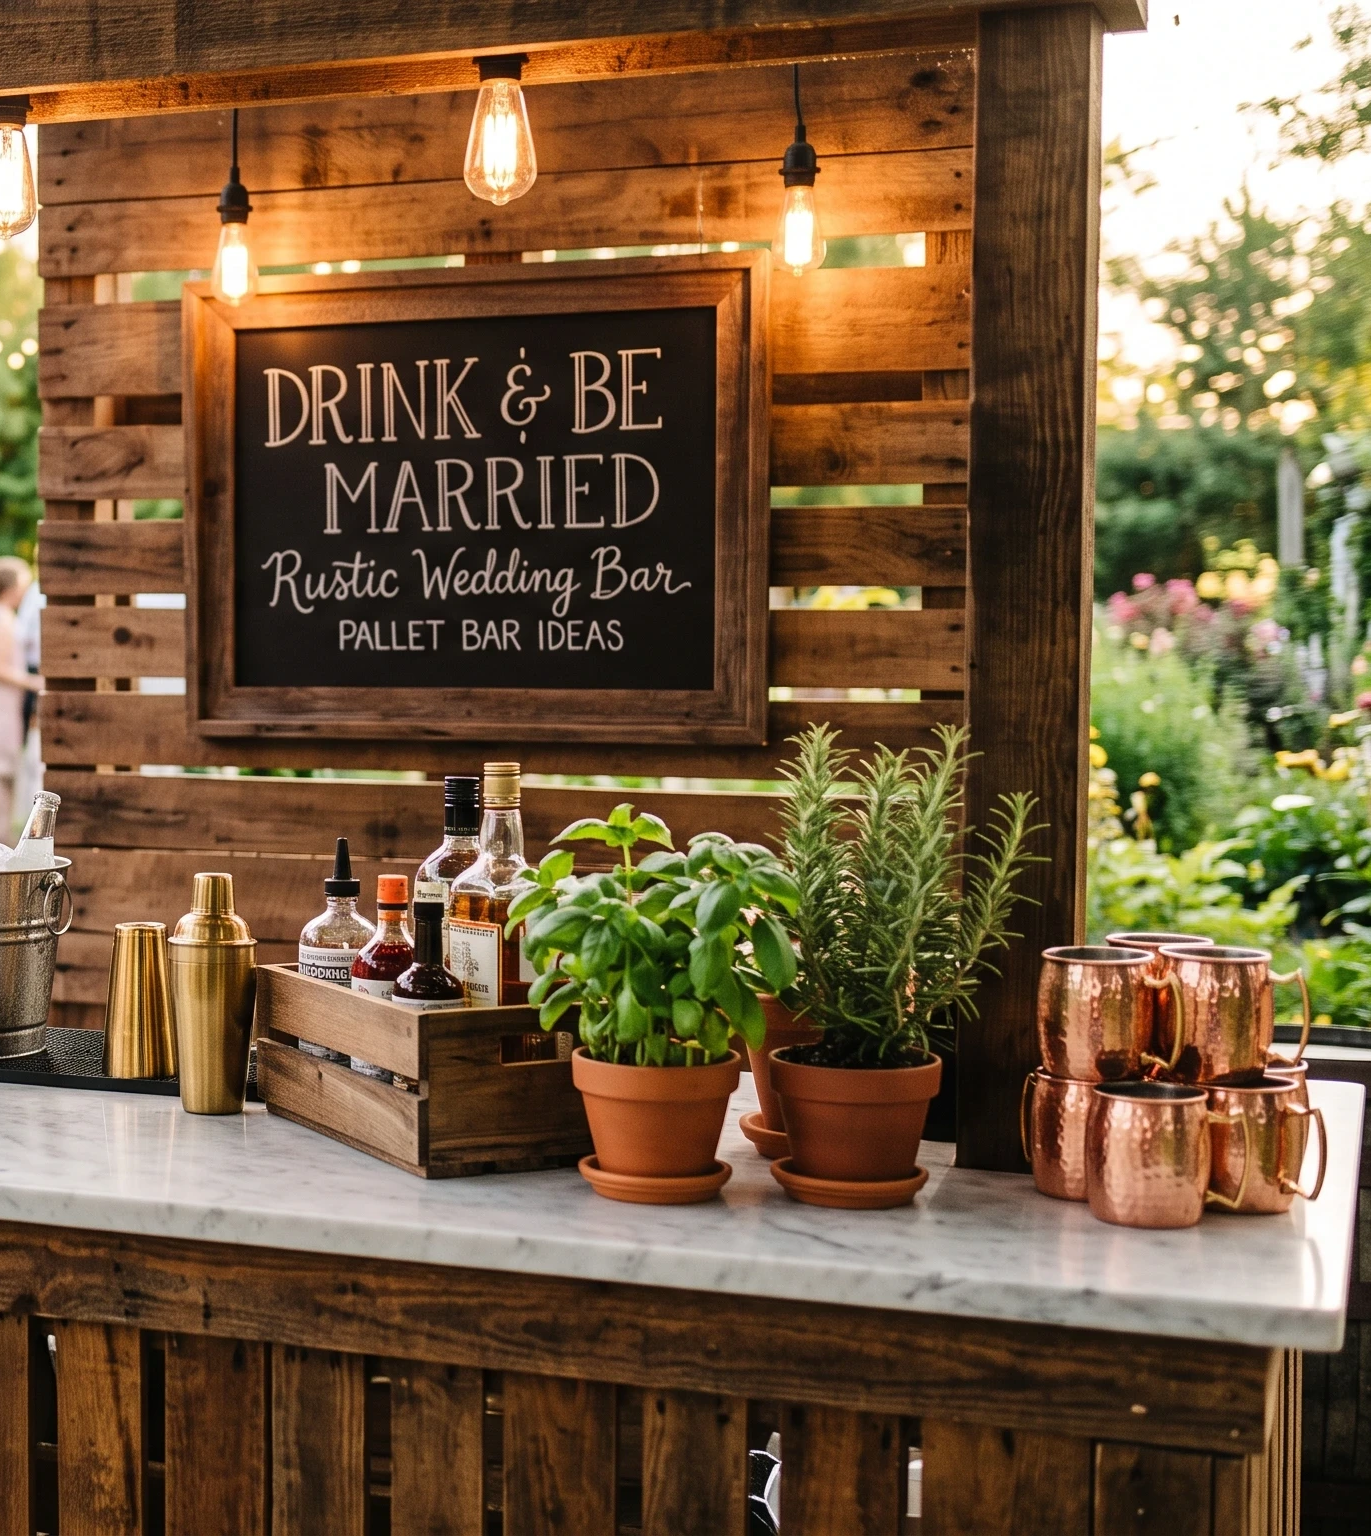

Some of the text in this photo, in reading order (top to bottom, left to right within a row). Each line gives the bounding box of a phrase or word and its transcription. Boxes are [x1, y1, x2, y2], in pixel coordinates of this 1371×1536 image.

[263, 347, 663, 448] DRINK & BE
[323, 453, 660, 535] MARRIED
[261, 545, 692, 618] Rustic Wedding Bar
[339, 619, 624, 651] PALLET BAR IDEAS
